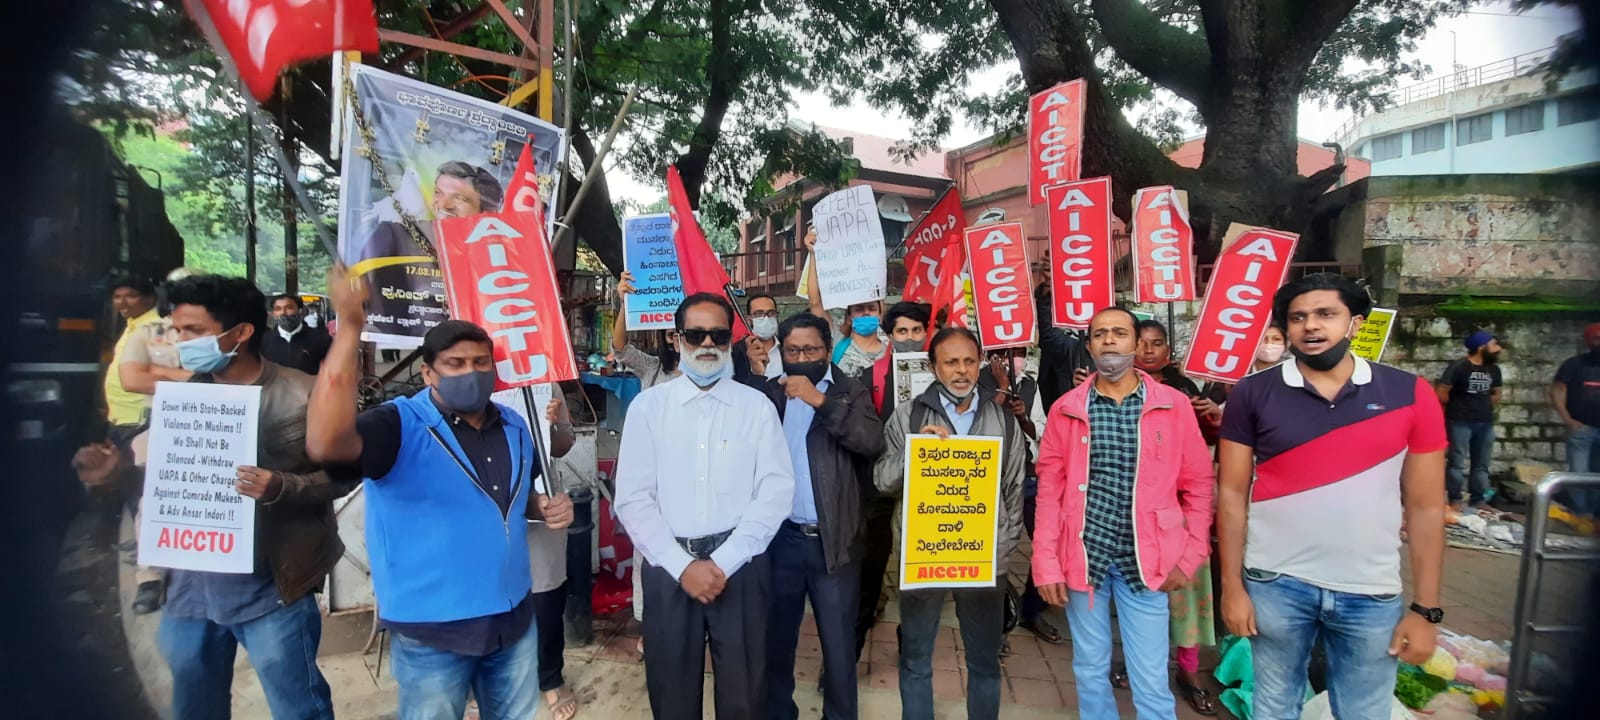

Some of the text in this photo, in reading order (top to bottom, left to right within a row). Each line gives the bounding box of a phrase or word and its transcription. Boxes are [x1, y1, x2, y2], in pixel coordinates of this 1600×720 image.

[1147, 191, 1182, 299] AICCTU
[1058, 188, 1095, 322] AICCTU
[979, 229, 1023, 341] AICCTU
[465, 217, 548, 384] AICCTU
[1204, 238, 1278, 373] AICCTU
[640, 313, 673, 323] AICC
[161, 401, 246, 416] Down With State-Backed
[163, 418, 242, 433] Violence On Muslims !!
[173, 437, 229, 450] We Shall Not Be
[166, 453, 234, 467] Silenced -Withdraw
[918, 447, 991, 465] ತ್ರಿಪುರ ರಾಜ್ಯದ
[159, 470, 236, 488] UAPA & Other Charge
[921, 466, 987, 483] ಮುಸಲ್ಮಾನರ
[153, 487, 243, 503] Against Comrade Mukesh
[159, 505, 234, 521] & Adv Ansar Indori !!
[917, 502, 987, 515] ಕೋಮುವಾದಿ
[938, 520, 964, 533] ದಾಳಿ
[157, 527, 234, 554] AICCTU
[917, 538, 984, 555] ನಿಲ್ಲಲೇಬೇಕು!
[917, 565, 979, 579] AICCTU
